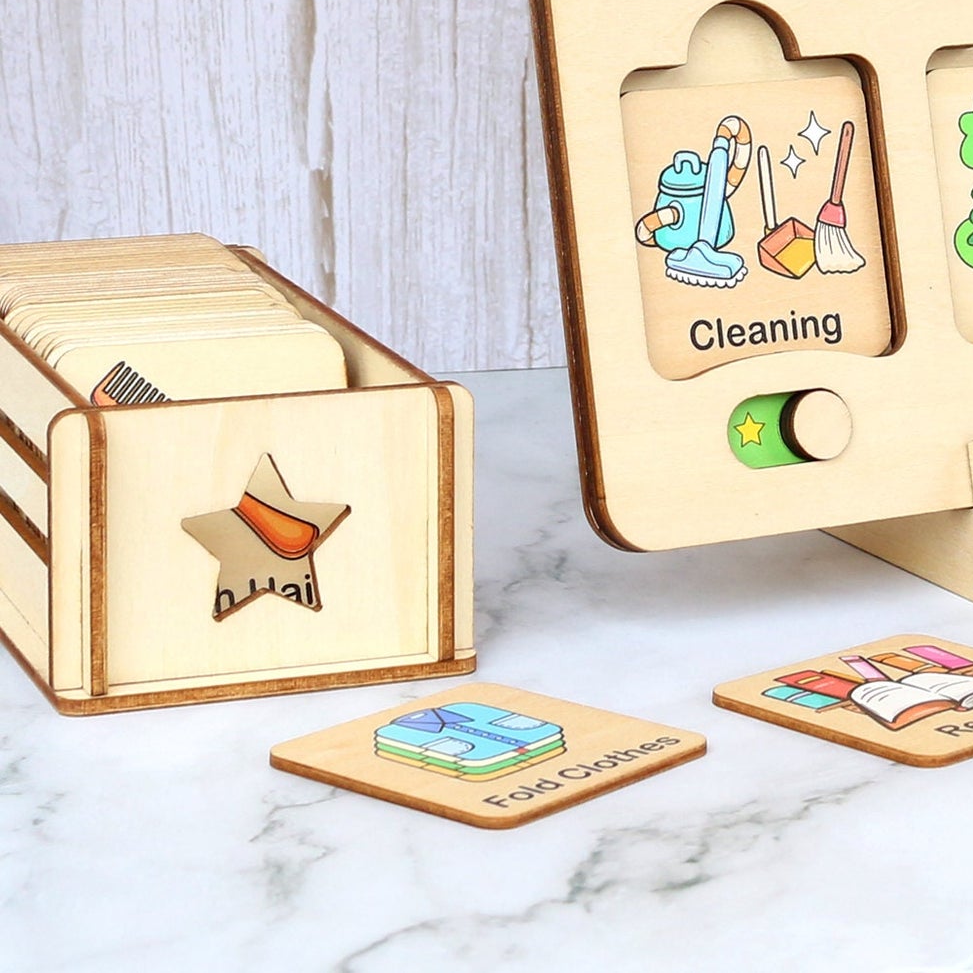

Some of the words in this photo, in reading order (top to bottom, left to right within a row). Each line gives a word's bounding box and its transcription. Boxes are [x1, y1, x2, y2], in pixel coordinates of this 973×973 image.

[689, 309, 843, 351] Cleaning
[482, 778, 565, 808] Fold
[557, 735, 681, 781] Clothes
